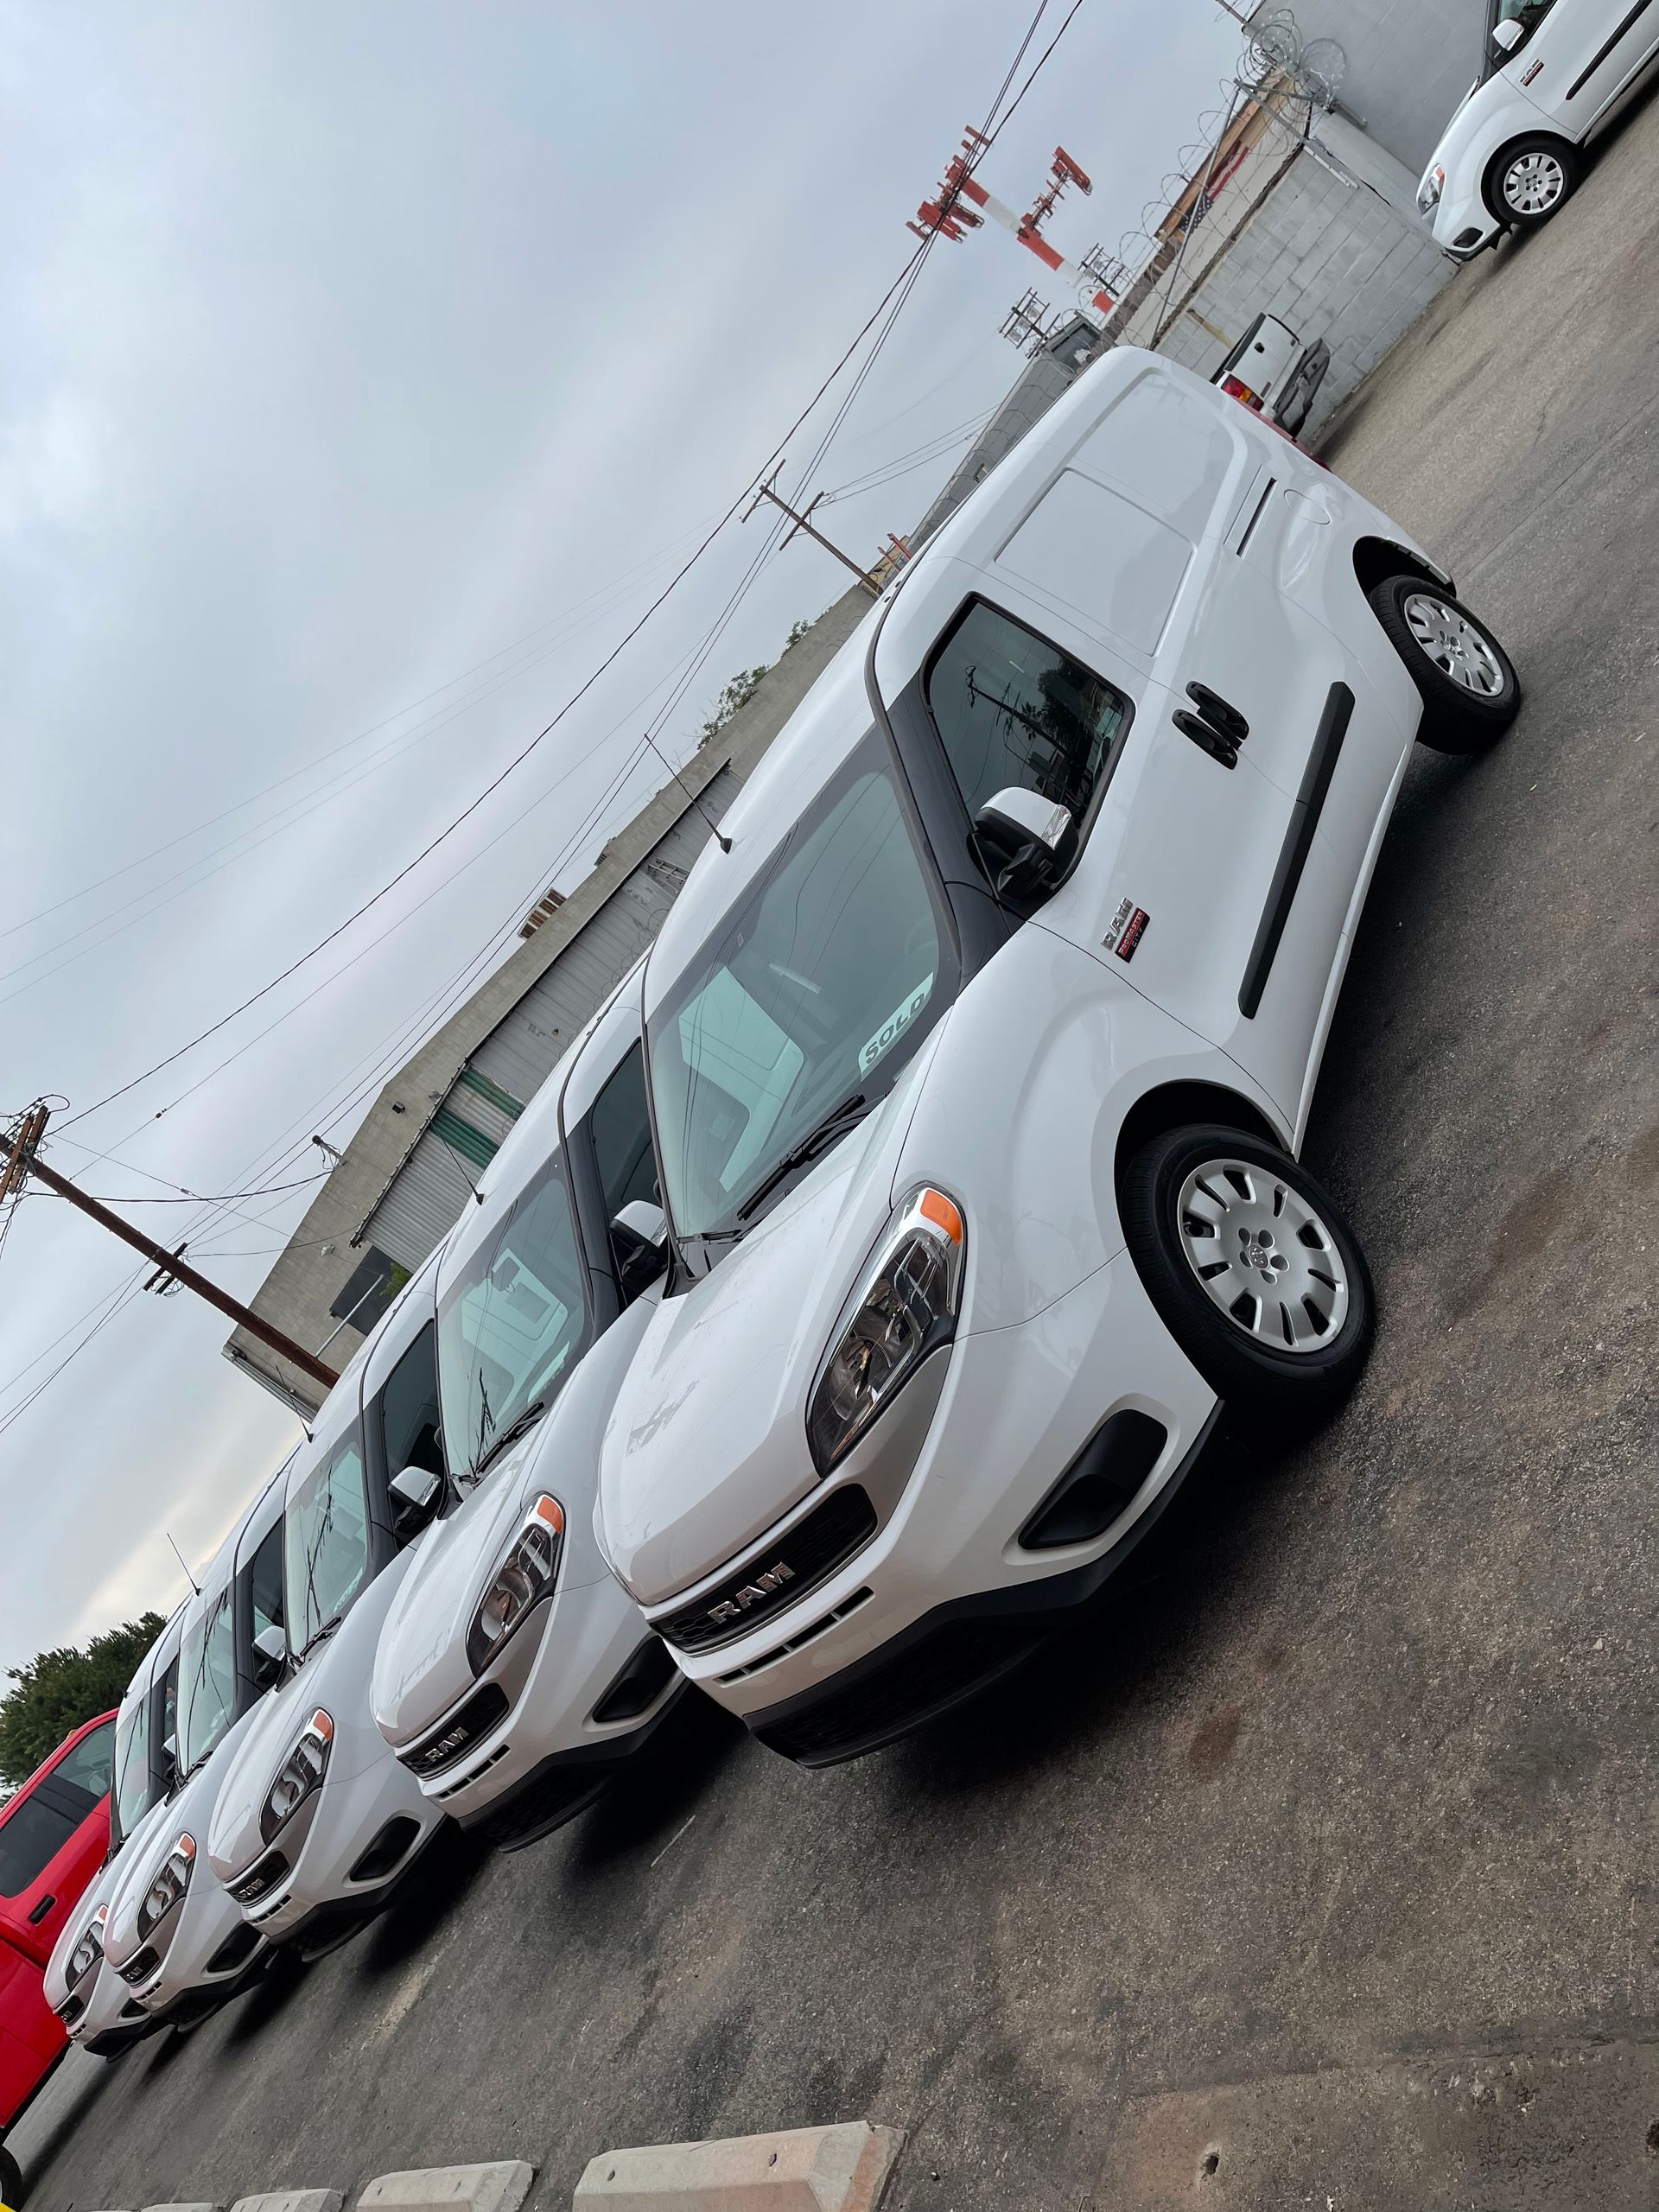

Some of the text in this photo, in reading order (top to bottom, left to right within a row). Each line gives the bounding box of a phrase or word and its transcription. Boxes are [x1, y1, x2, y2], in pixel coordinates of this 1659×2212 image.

[1100, 897, 1133, 951] RAM
[1131, 926, 1143, 948] CITY
[865, 993, 925, 1065] SOLD
[707, 1561, 795, 1624] RAM
[425, 1726, 469, 1762] RAM
